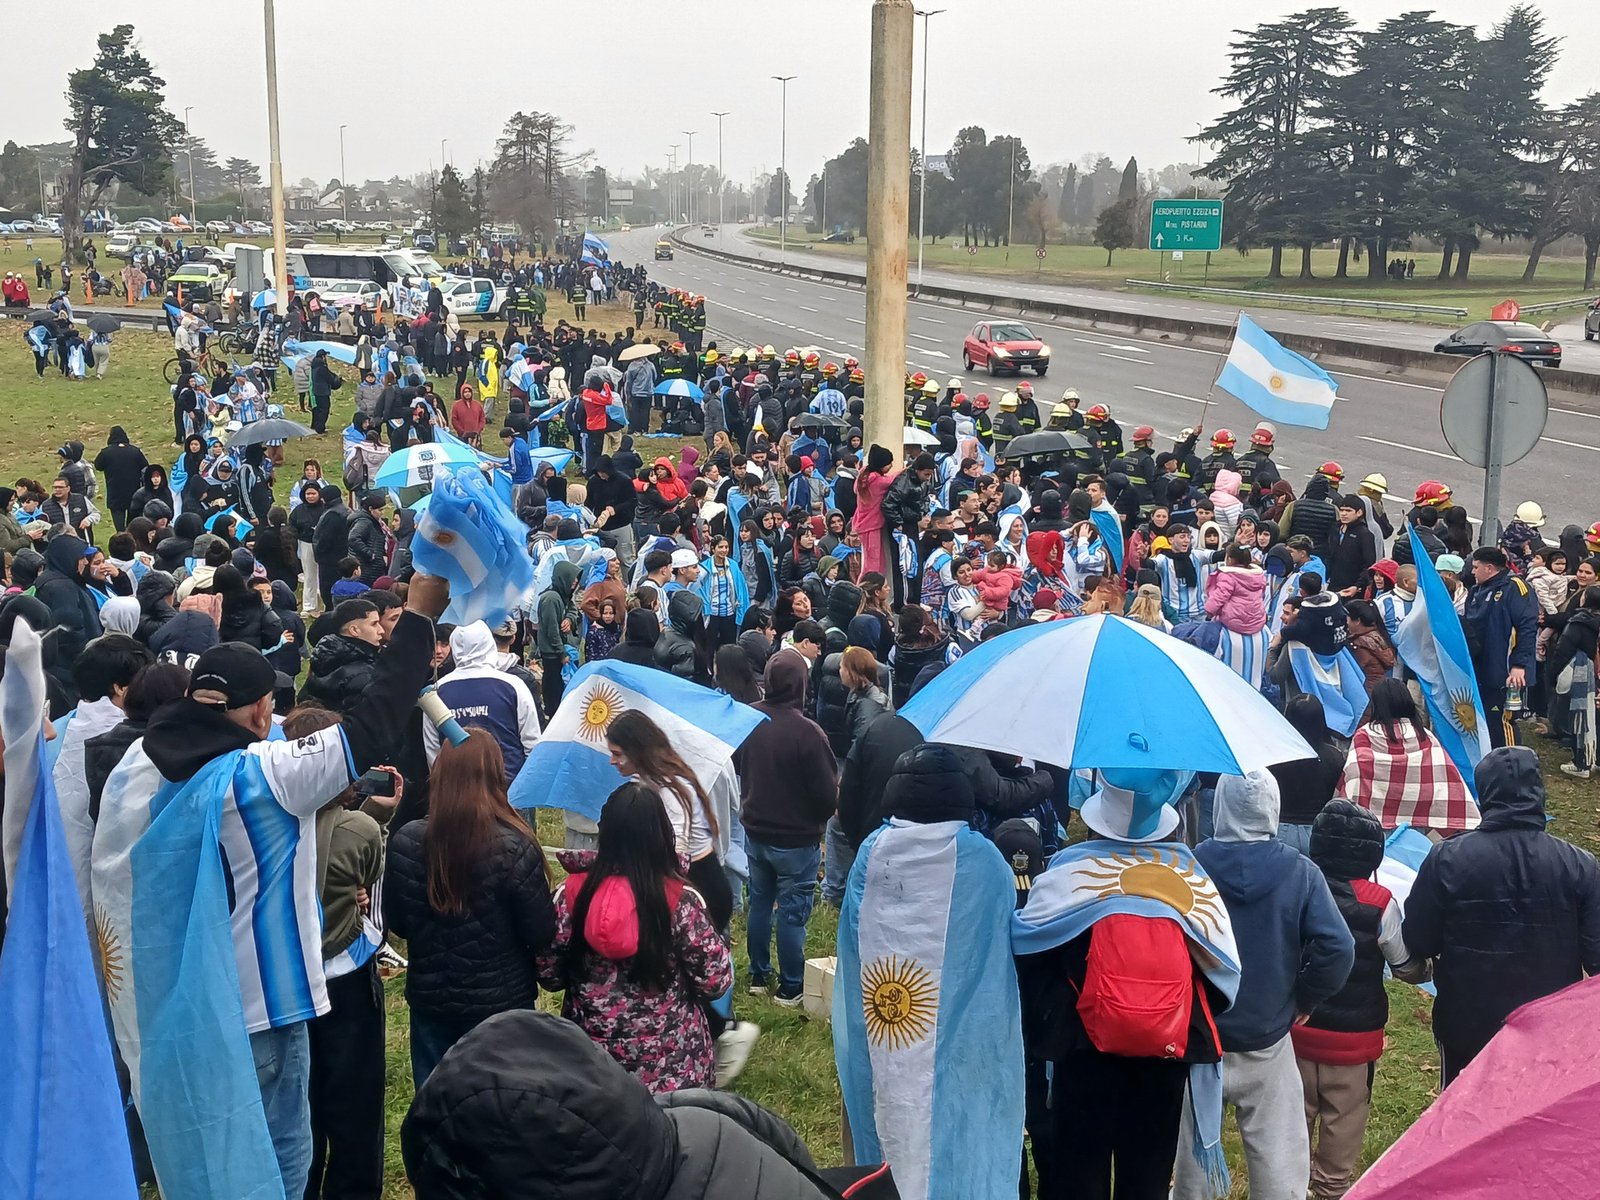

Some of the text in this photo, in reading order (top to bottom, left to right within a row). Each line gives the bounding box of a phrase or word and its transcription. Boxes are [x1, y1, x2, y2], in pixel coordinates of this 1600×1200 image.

[1155, 207, 1212, 216] AEROPUERTO EZEIZA
[1180, 220, 1207, 229] PISTARINI
[1176, 234, 1180, 242] 3
